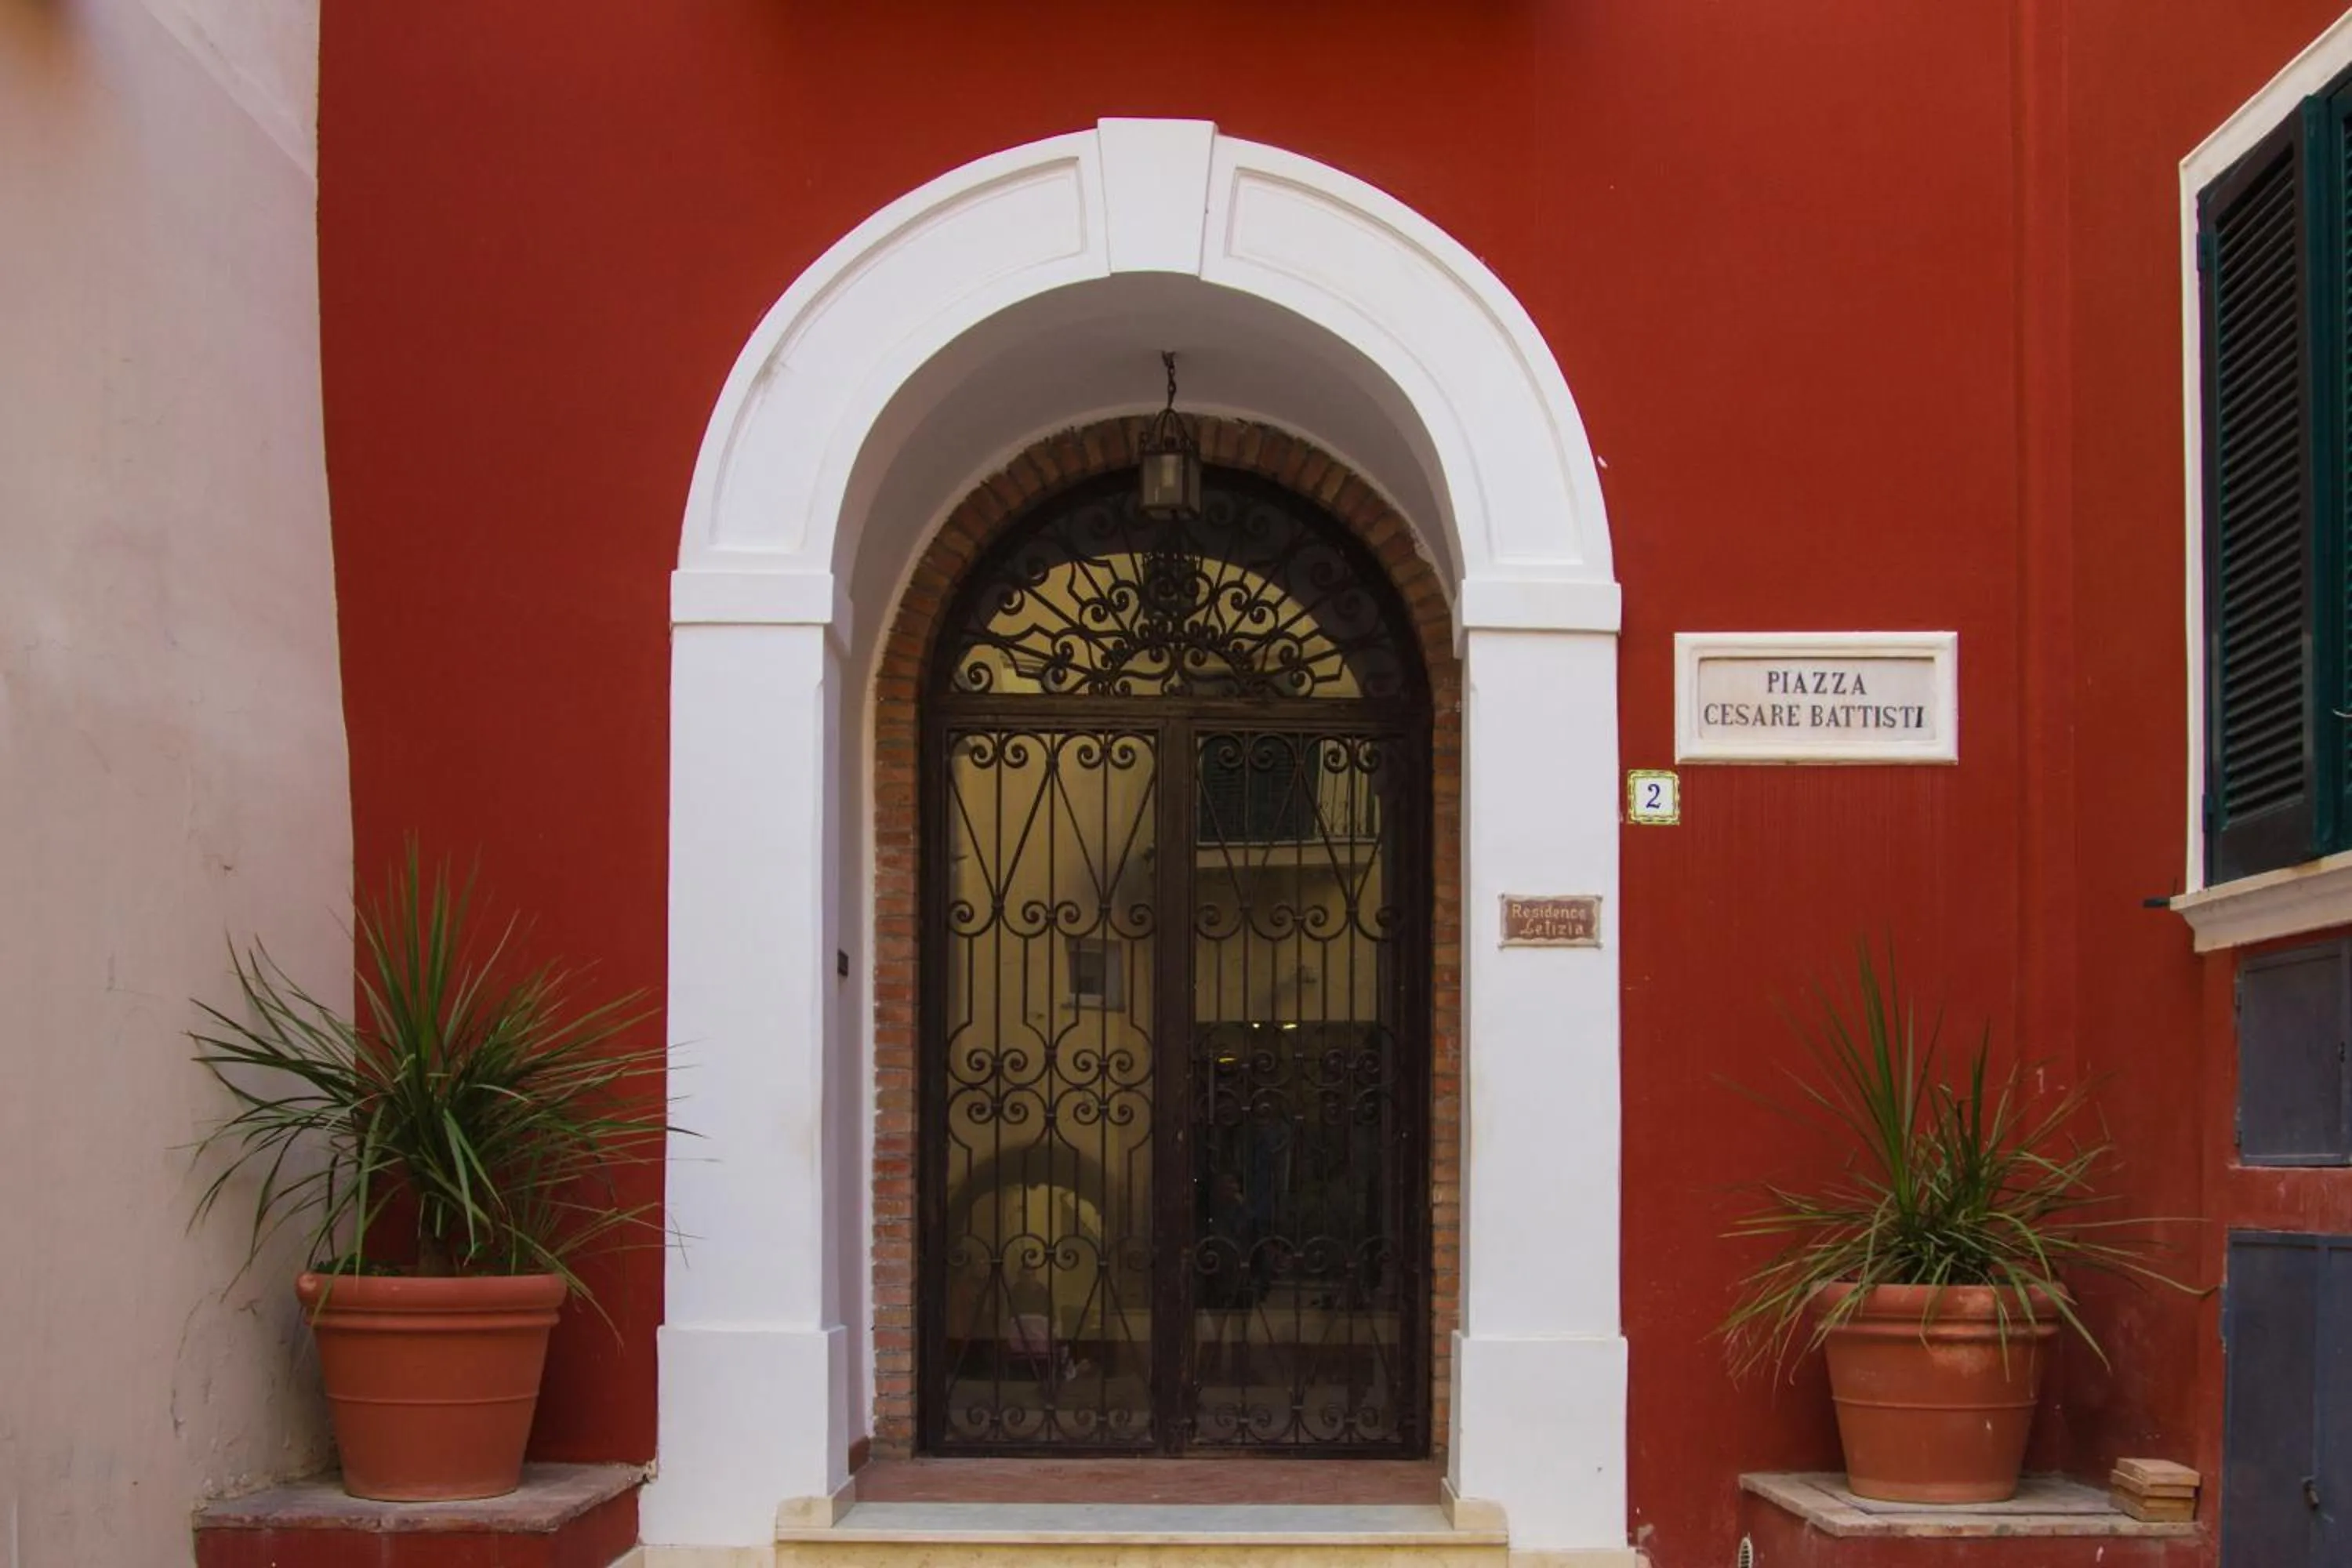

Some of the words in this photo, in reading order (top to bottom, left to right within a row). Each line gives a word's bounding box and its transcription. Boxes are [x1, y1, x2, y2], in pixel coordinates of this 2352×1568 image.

[1766, 671, 1867, 695] PIAZZA
[1704, 703, 1800, 727] CESARE
[1809, 705, 1925, 728] BATTISTI
[1646, 783, 1661, 809] 2
[1512, 902, 1586, 920] Residence
